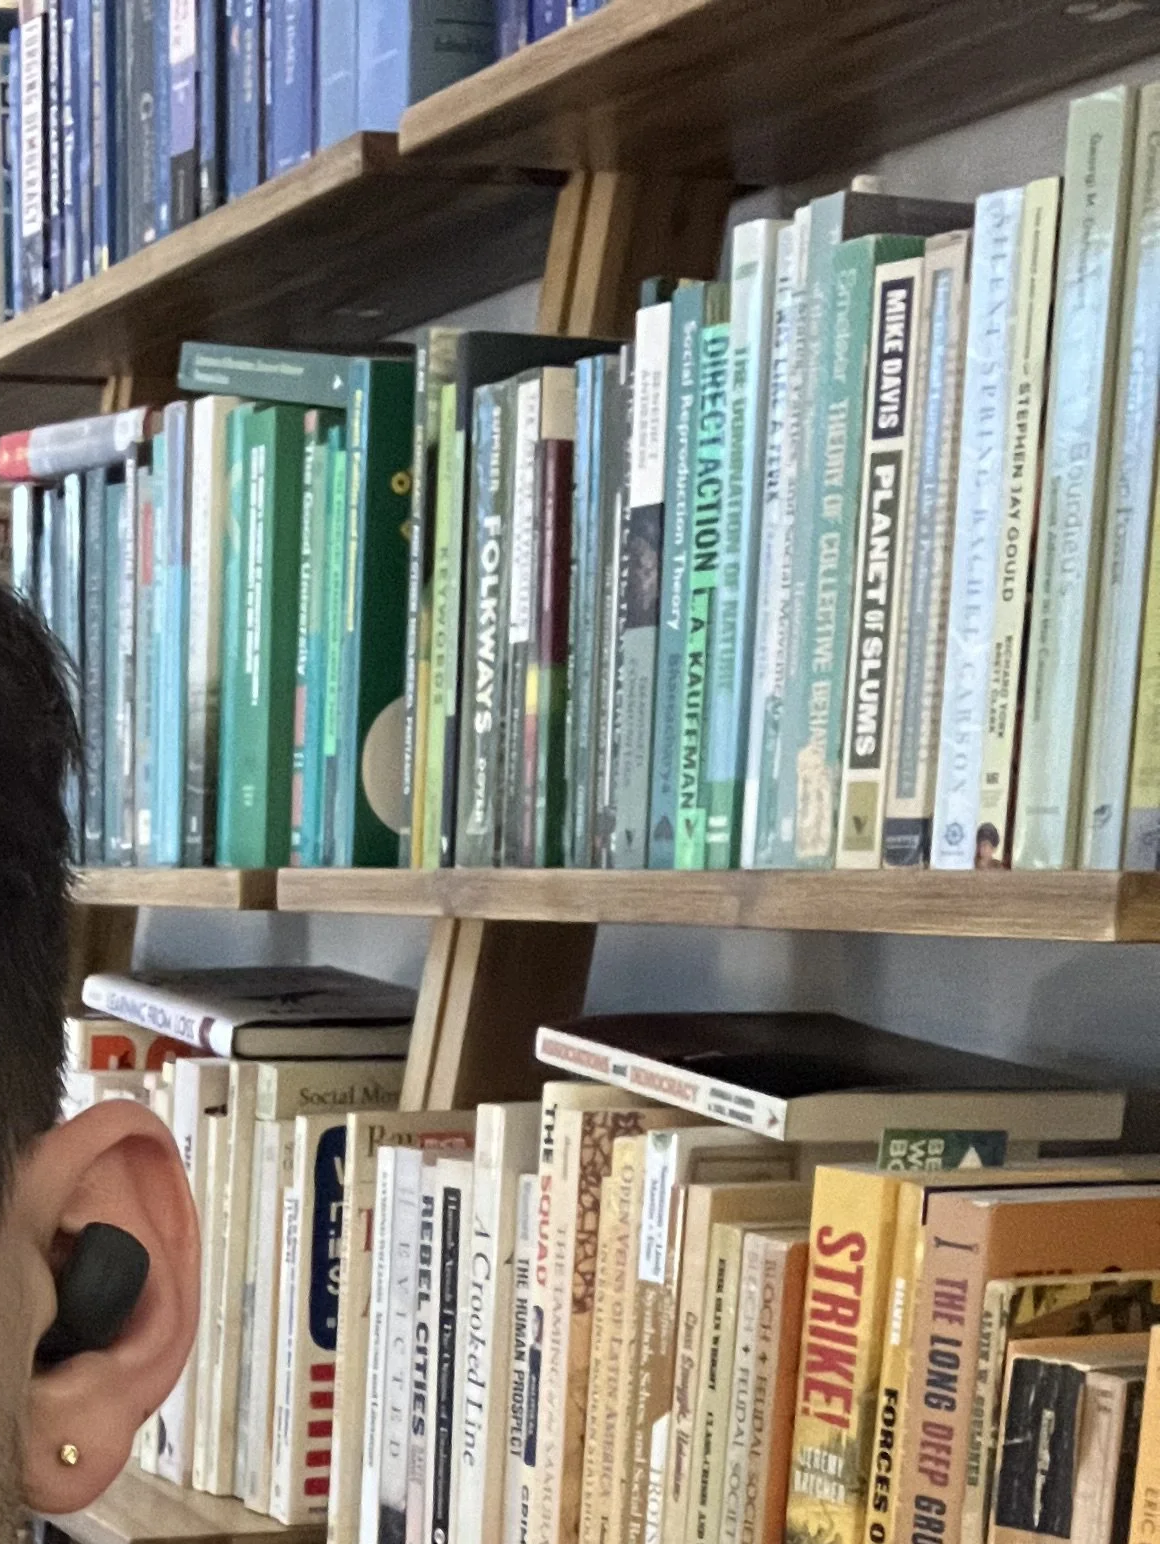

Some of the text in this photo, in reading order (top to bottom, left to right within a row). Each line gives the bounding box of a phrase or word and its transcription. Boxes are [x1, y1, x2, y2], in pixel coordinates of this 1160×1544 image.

[23, 24, 40, 225] FORGING DEMOCRACY
[876, 288, 907, 429] MIKE DAVIS
[664, 320, 697, 631] Social Reproduction Theory
[693, 336, 730, 573] DIRECT ACTION
[1001, 382, 1031, 602] STEPHEN JAY GOULD
[297, 440, 315, 677] The Good University
[474, 405, 502, 735] SUMNER FOLKWAYS
[717, 348, 749, 697] THE DOMINATION OF NATURE
[811, 400, 849, 673] THEORY OF COLLECTIVE
[434, 546, 449, 706] KEYWORDS
[855, 464, 896, 757] PLANET OF SLUMS
[680, 651, 704, 810] KAUFFMAN
[949, 661, 977, 799] CARSON
[996, 634, 1014, 740] RICHARD YORK
[299, 1086, 354, 1106] Social
[537, 1102, 558, 1289] THE SQUAD
[414, 1194, 436, 1313] REBEL
[553, 1225, 568, 1274] THE
[714, 1258, 728, 1293] ERIK
[388, 1242, 411, 1460] EVICTED
[440, 1323, 453, 1347] The
[461, 1213, 492, 1468] A Crooked Line
[546, 1281, 567, 1383] TAMING
[600, 1163, 634, 1499] OPEN VEINS OF LATIN AMERICA
[638, 1290, 657, 1367] Symbols,
[683, 1311, 698, 1350] Class
[712, 1297, 725, 1331] OLIN
[802, 1225, 866, 1430] STRIKE!
[890, 1276, 907, 1346] SILVER
[932, 1277, 968, 1325] THE
[410, 1321, 429, 1437] CITIES
[509, 1257, 531, 1459] THE HUMAN PROSPECT
[706, 1335, 722, 1392] WRIGHT
[732, 1366, 751, 1449] FEUDAL
[922, 1332, 960, 1413] LONG
[367, 1402, 379, 1469] Literature
[633, 1430, 646, 1464] and
[748, 1374, 770, 1459] FEUDAL
[798, 1446, 846, 1481] JEREMY
[873, 1388, 900, 1512] FORCES
[917, 1420, 954, 1488] DEEP
[966, 1395, 986, 1488] GOULDNER
[629, 1468, 644, 1517] Social
[696, 1510, 708, 1539] AND
[698, 1459, 712, 1507] CRISIS
[794, 1470, 848, 1502] BRECHER
[1139, 1486, 1158, 1536] ERIC
